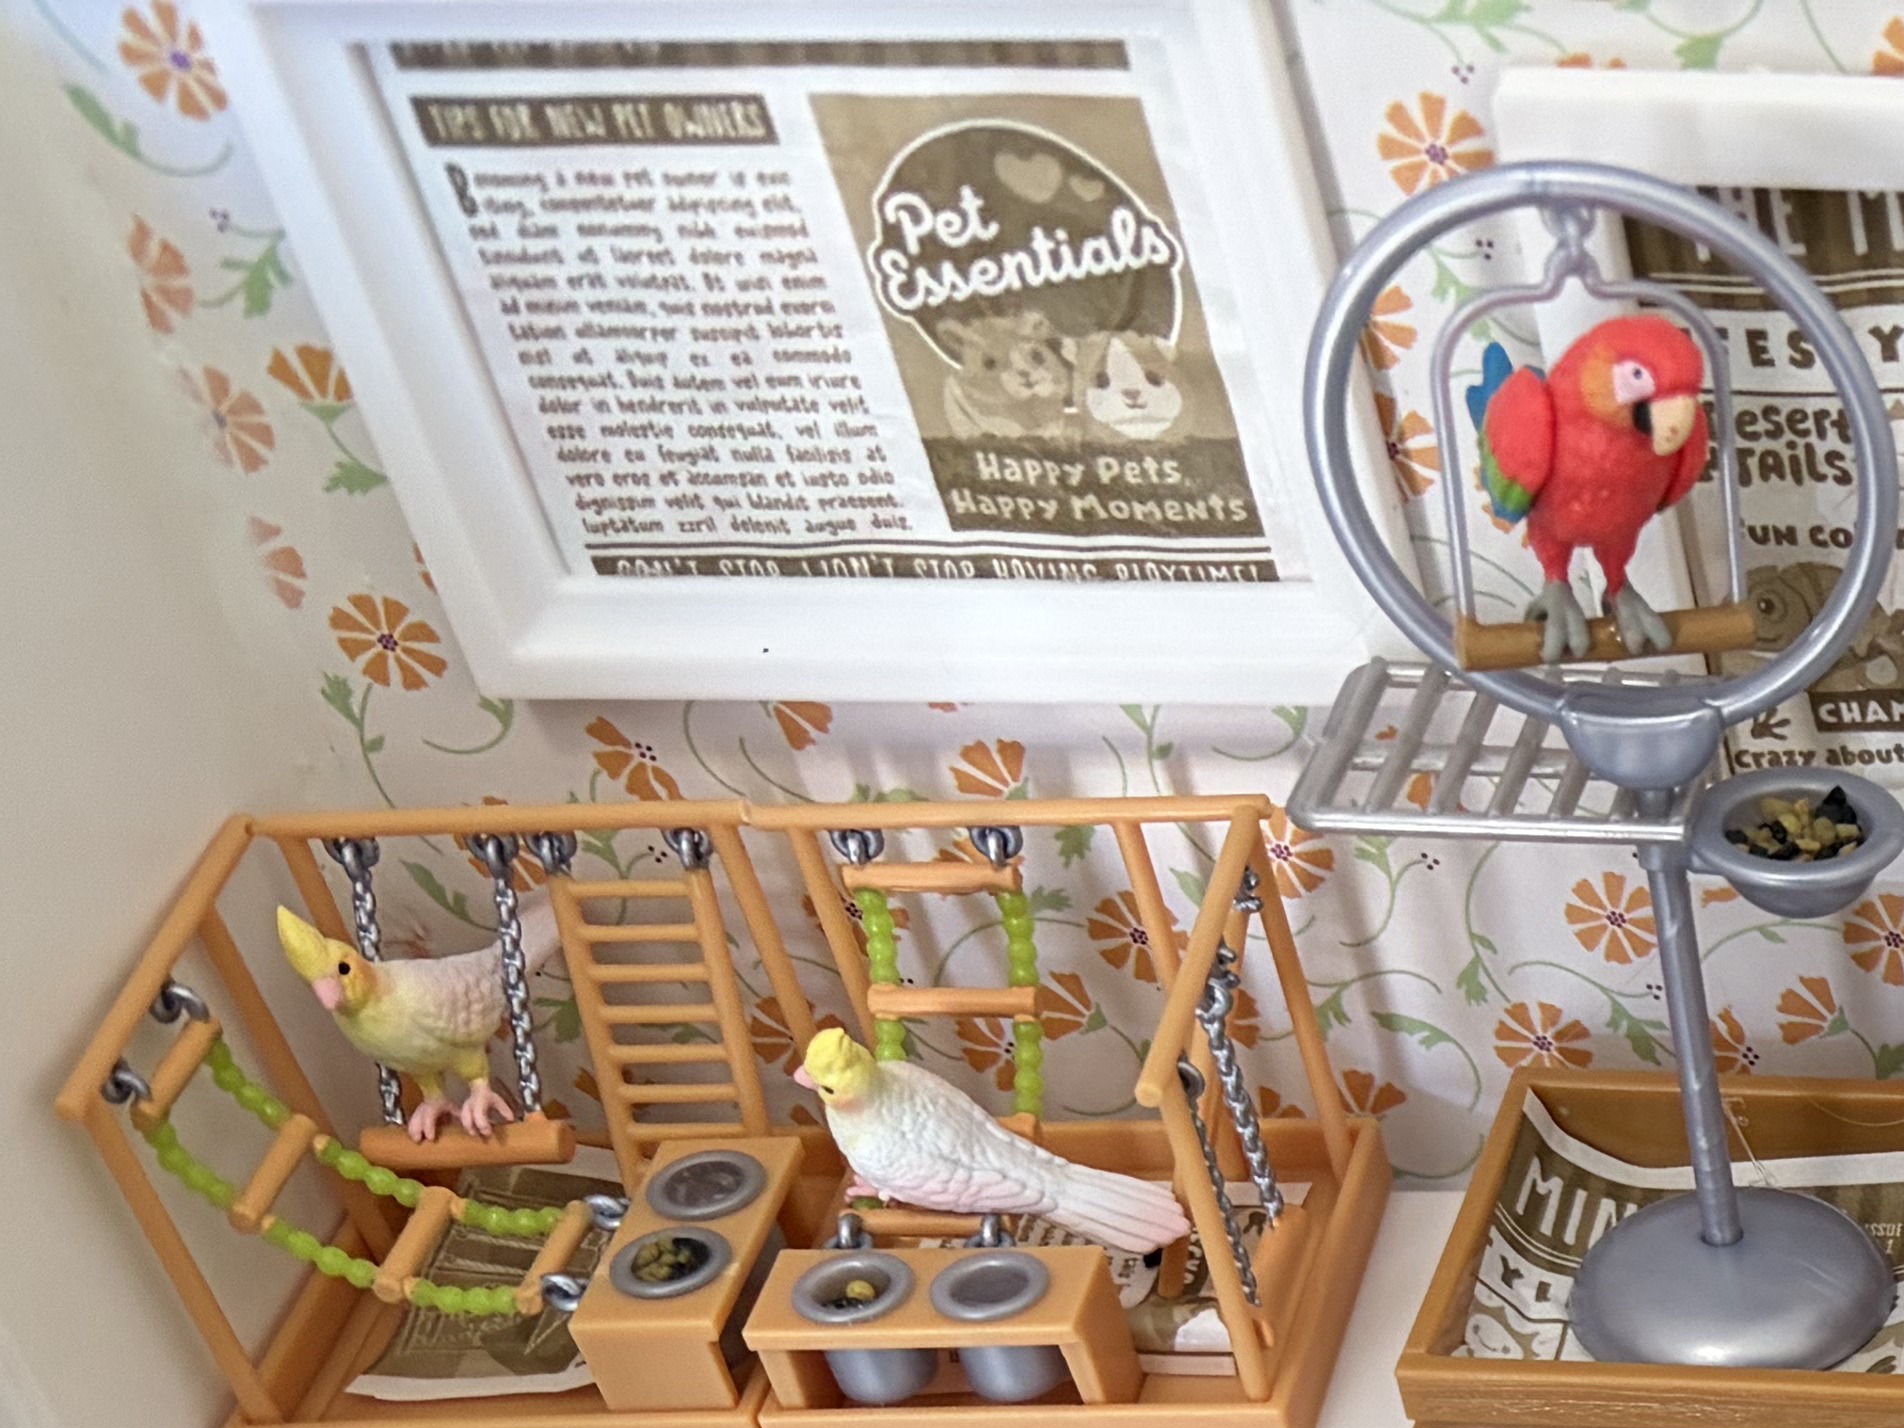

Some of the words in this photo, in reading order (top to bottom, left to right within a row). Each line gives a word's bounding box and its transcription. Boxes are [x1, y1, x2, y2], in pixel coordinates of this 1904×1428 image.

[885, 184, 1000, 255] Pet
[880, 207, 1170, 310] Essentials
[976, 450, 1087, 485] Happy
[950, 488, 1059, 522] Happy
[1516, 1154, 1638, 1246] MIN
